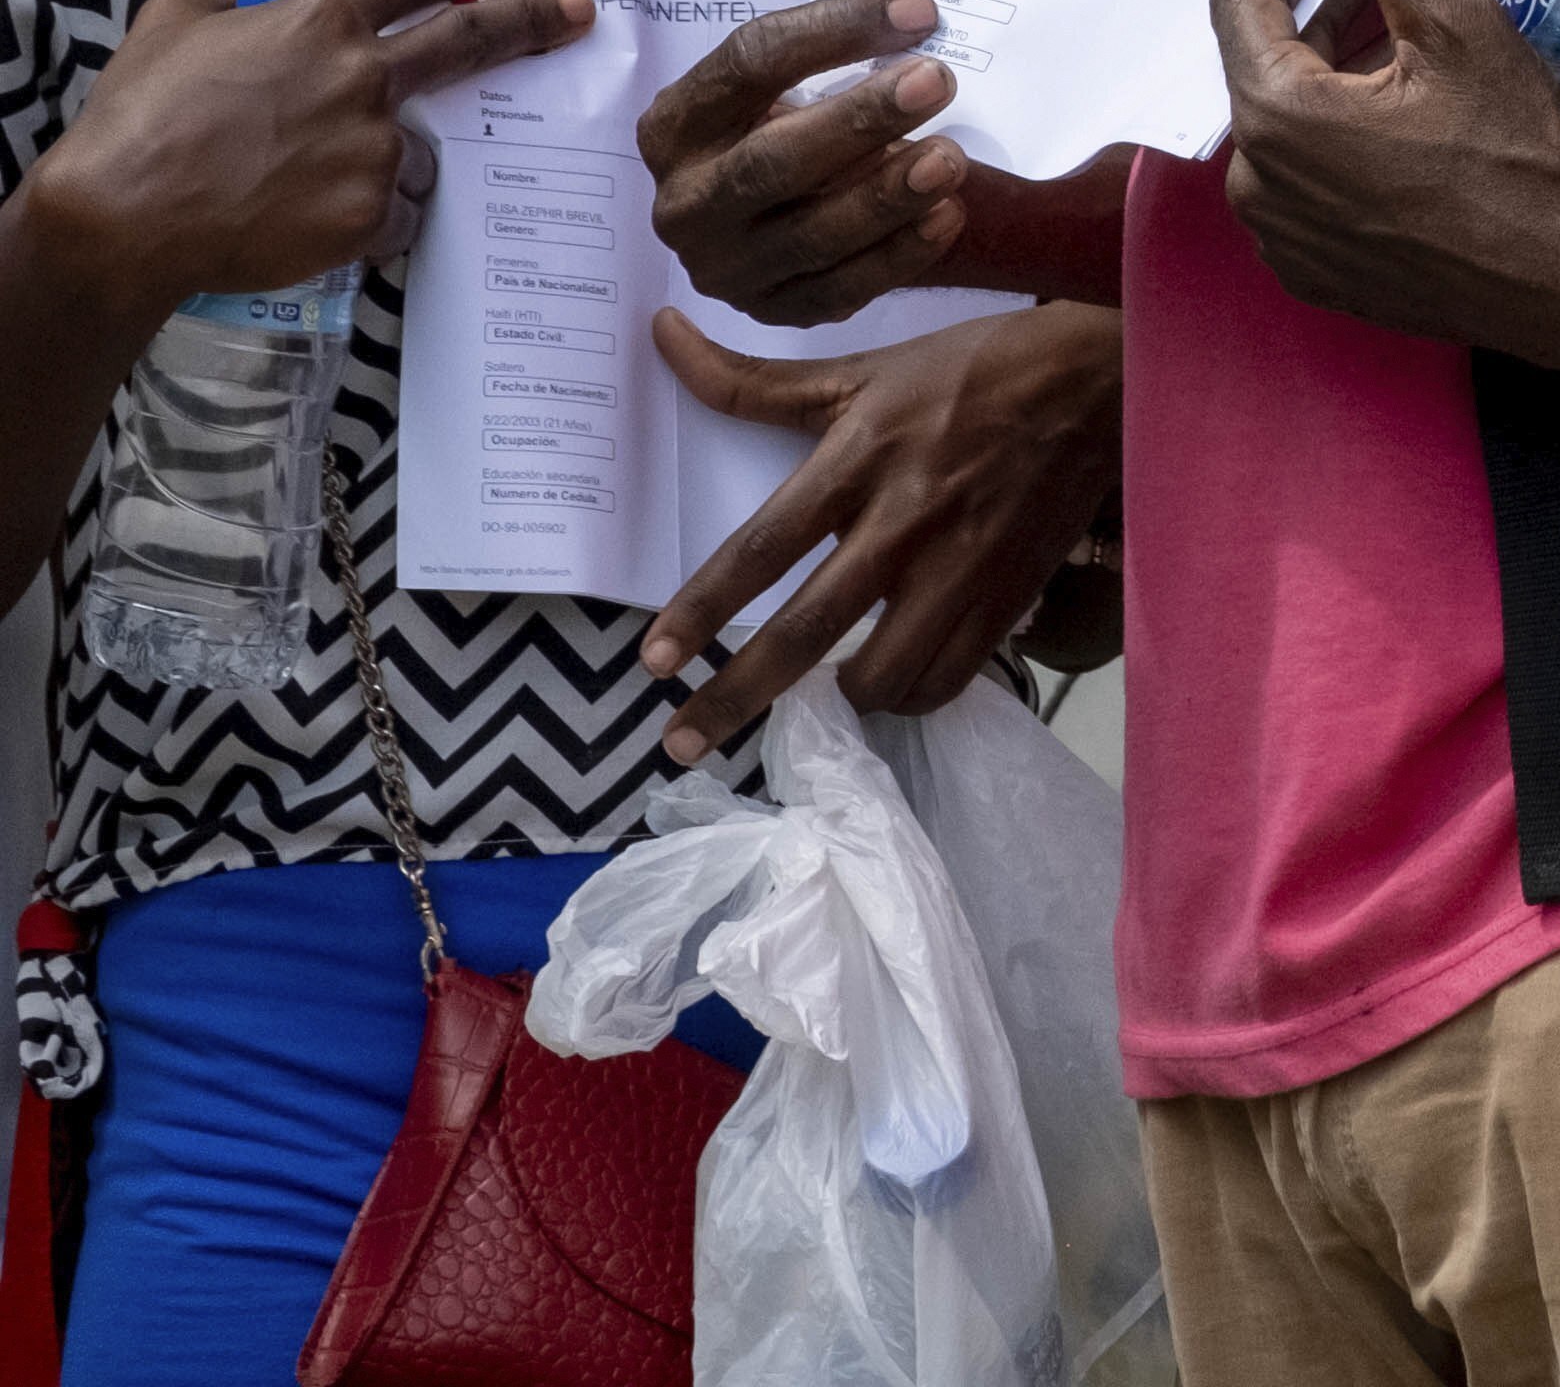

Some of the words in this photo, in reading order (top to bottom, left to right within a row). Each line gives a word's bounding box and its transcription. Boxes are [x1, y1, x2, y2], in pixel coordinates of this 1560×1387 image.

[480, 90, 513, 102] Datos
[481, 107, 544, 122] Personales
[492, 170, 540, 184] Nombre:
[486, 203, 518, 214] ELISA
[521, 207, 563, 220] ZEPHIR
[486, 255, 539, 269] Femenino
[522, 278, 535, 288] de
[539, 280, 609, 296] Nacionalidad:
[515, 310, 542, 323] (HTI)
[494, 328, 534, 340] Estado
[537, 331, 566, 343] Civil:
[484, 362, 525, 373] Soltero
[492, 381, 530, 393] Fecha
[533, 382, 547, 394] de
[490, 489, 539, 500] Numero
[543, 490, 558, 500] de
